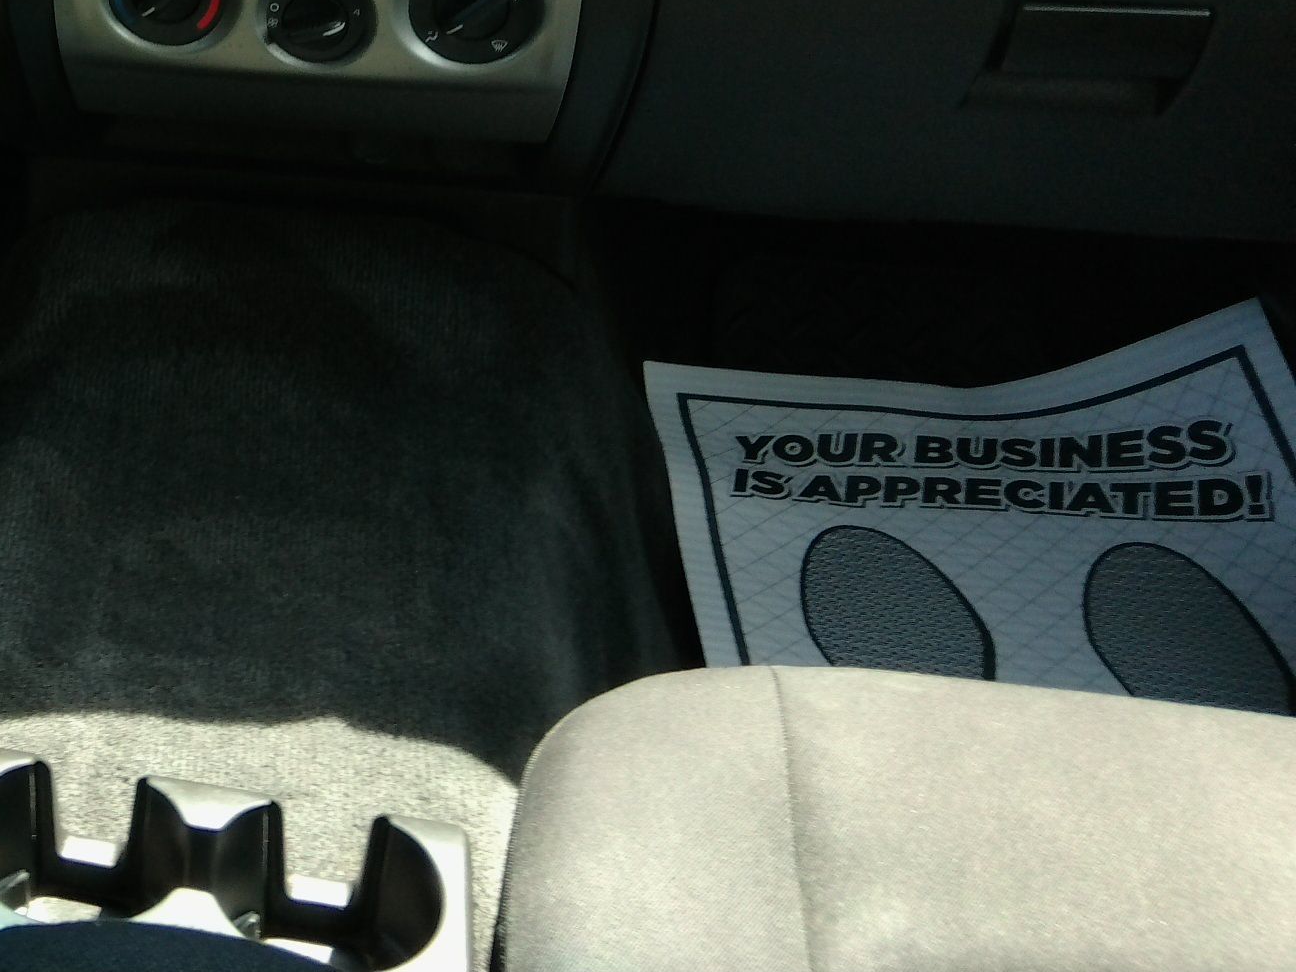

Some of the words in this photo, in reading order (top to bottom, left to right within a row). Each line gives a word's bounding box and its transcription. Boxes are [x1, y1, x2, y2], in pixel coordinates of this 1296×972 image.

[734, 430, 904, 469] YOUR
[910, 418, 1234, 473] BUSINESS
[730, 466, 794, 500] IS
[791, 470, 1275, 523] APPRECIATED!
